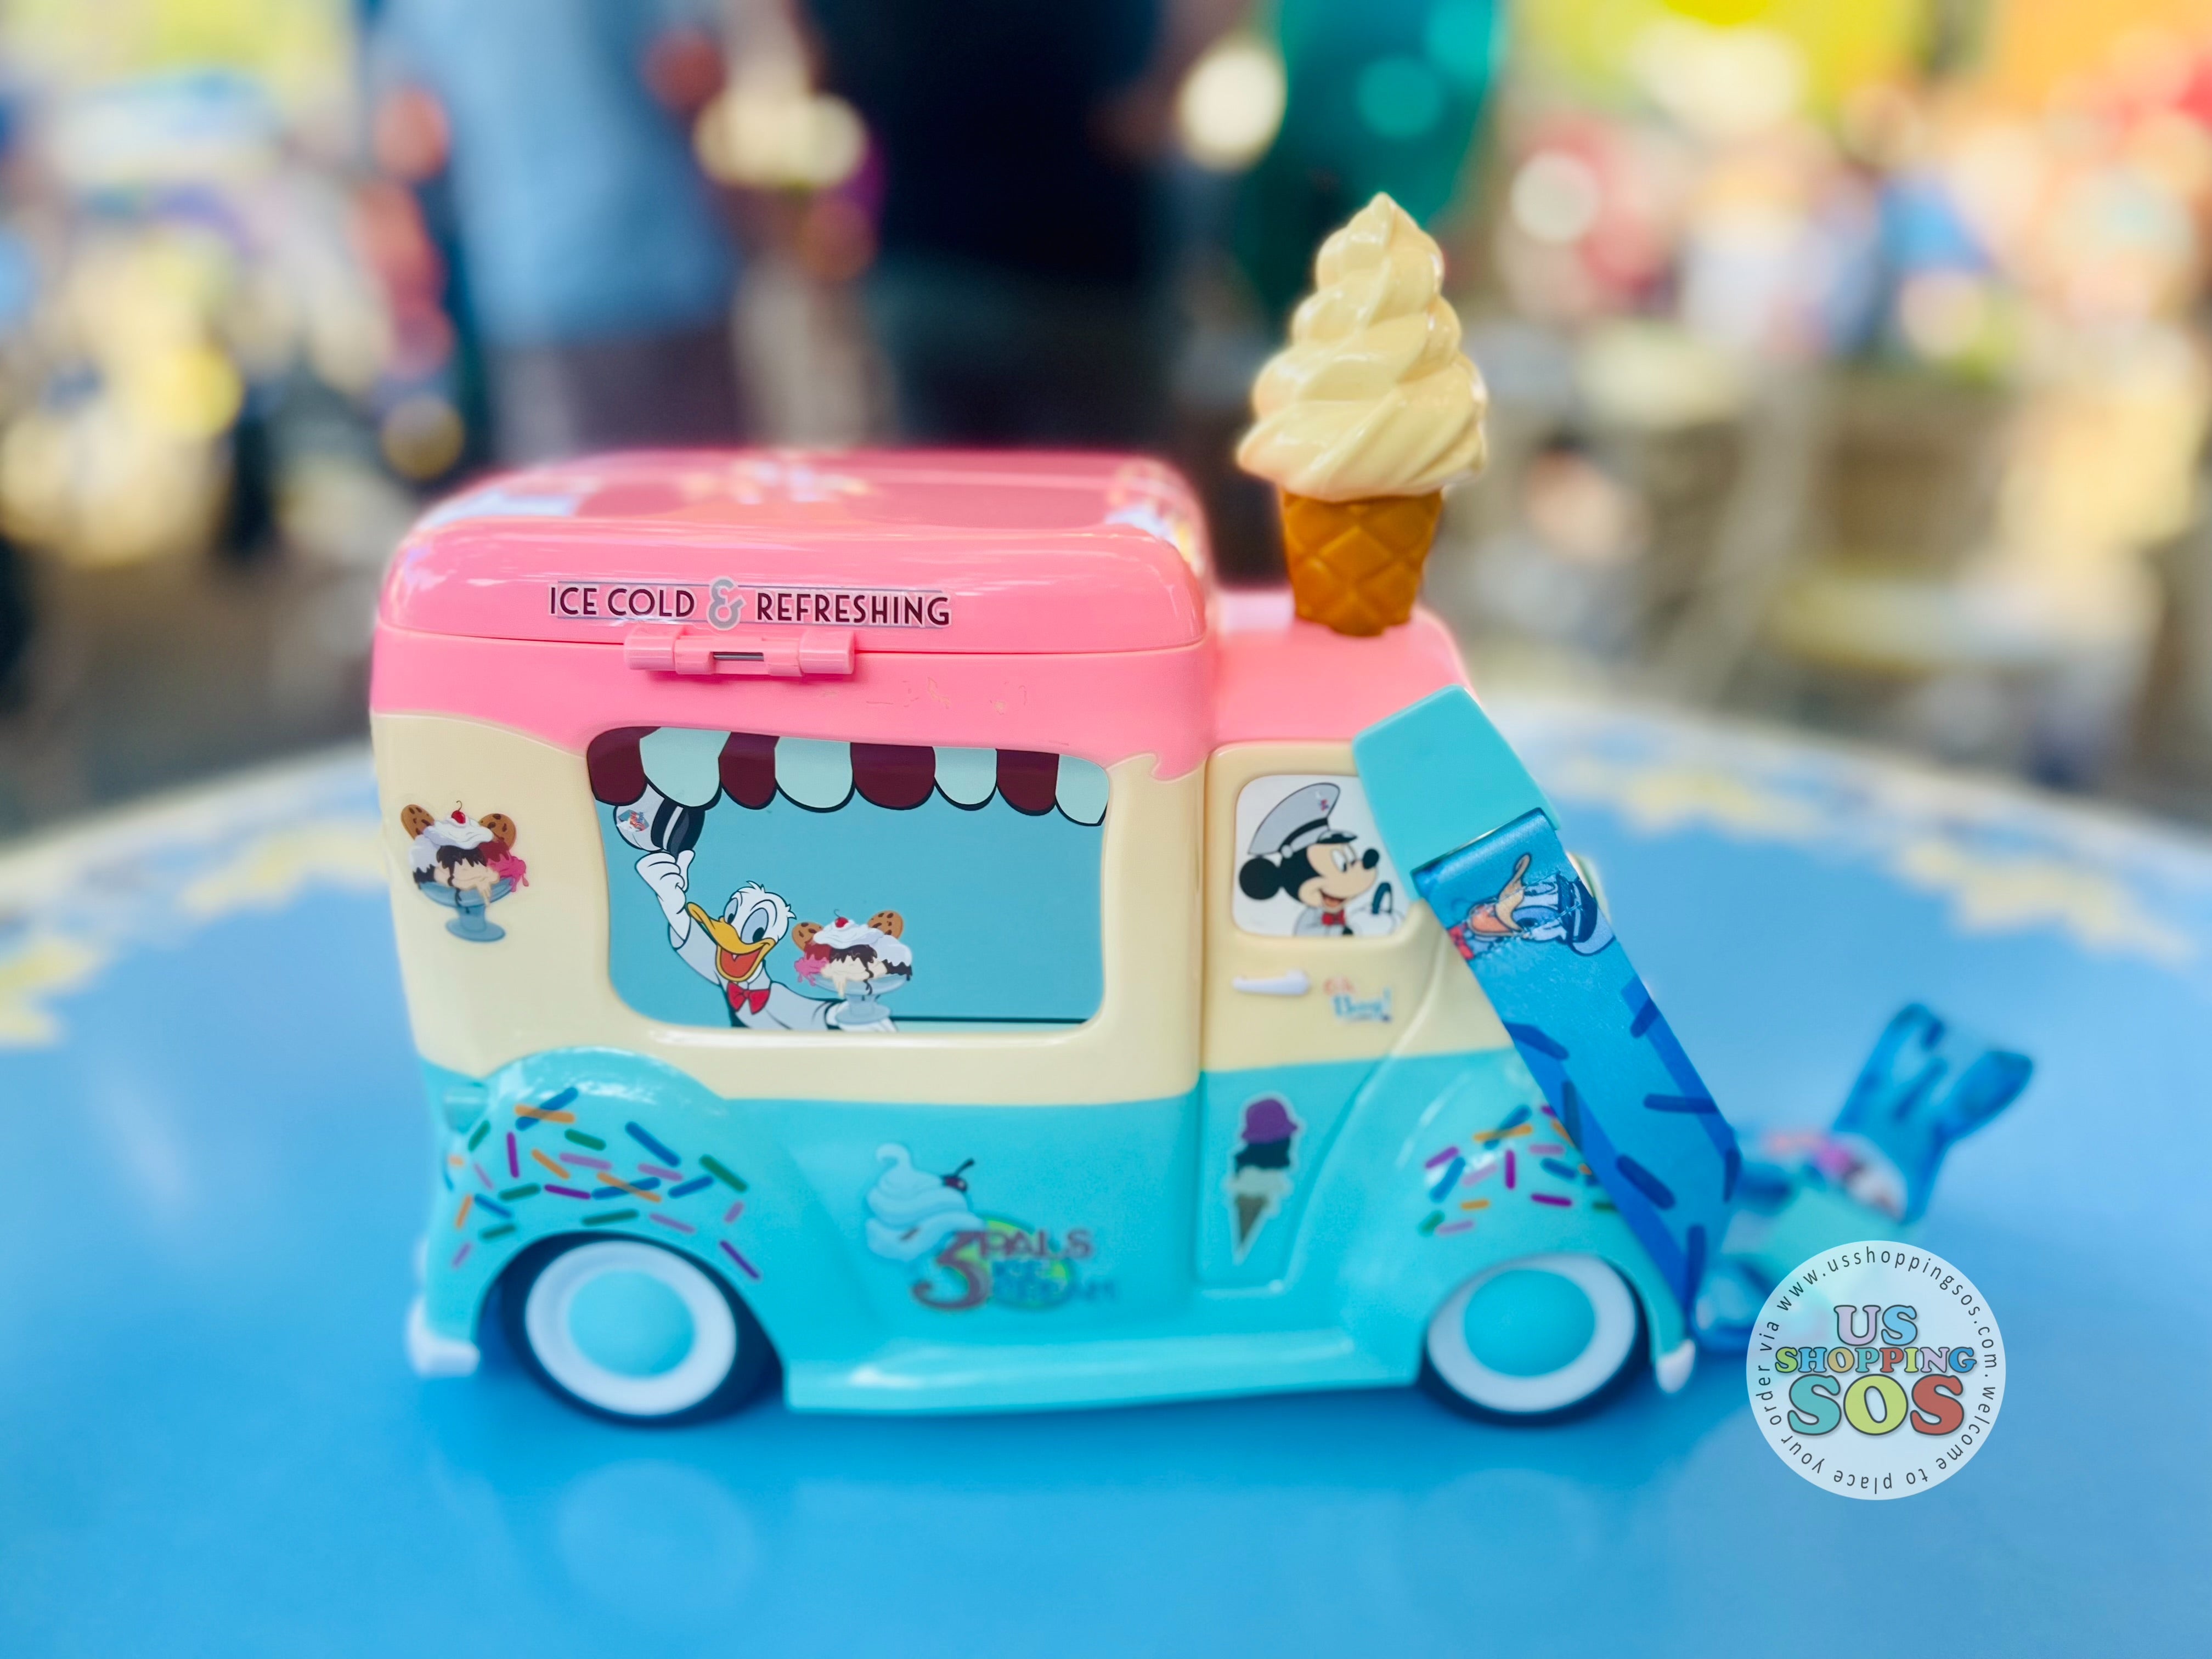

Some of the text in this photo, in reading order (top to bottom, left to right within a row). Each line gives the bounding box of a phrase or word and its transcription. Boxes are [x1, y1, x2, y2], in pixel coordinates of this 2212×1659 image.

[550, 577, 950, 629] ICE COLD & REFRESHING
